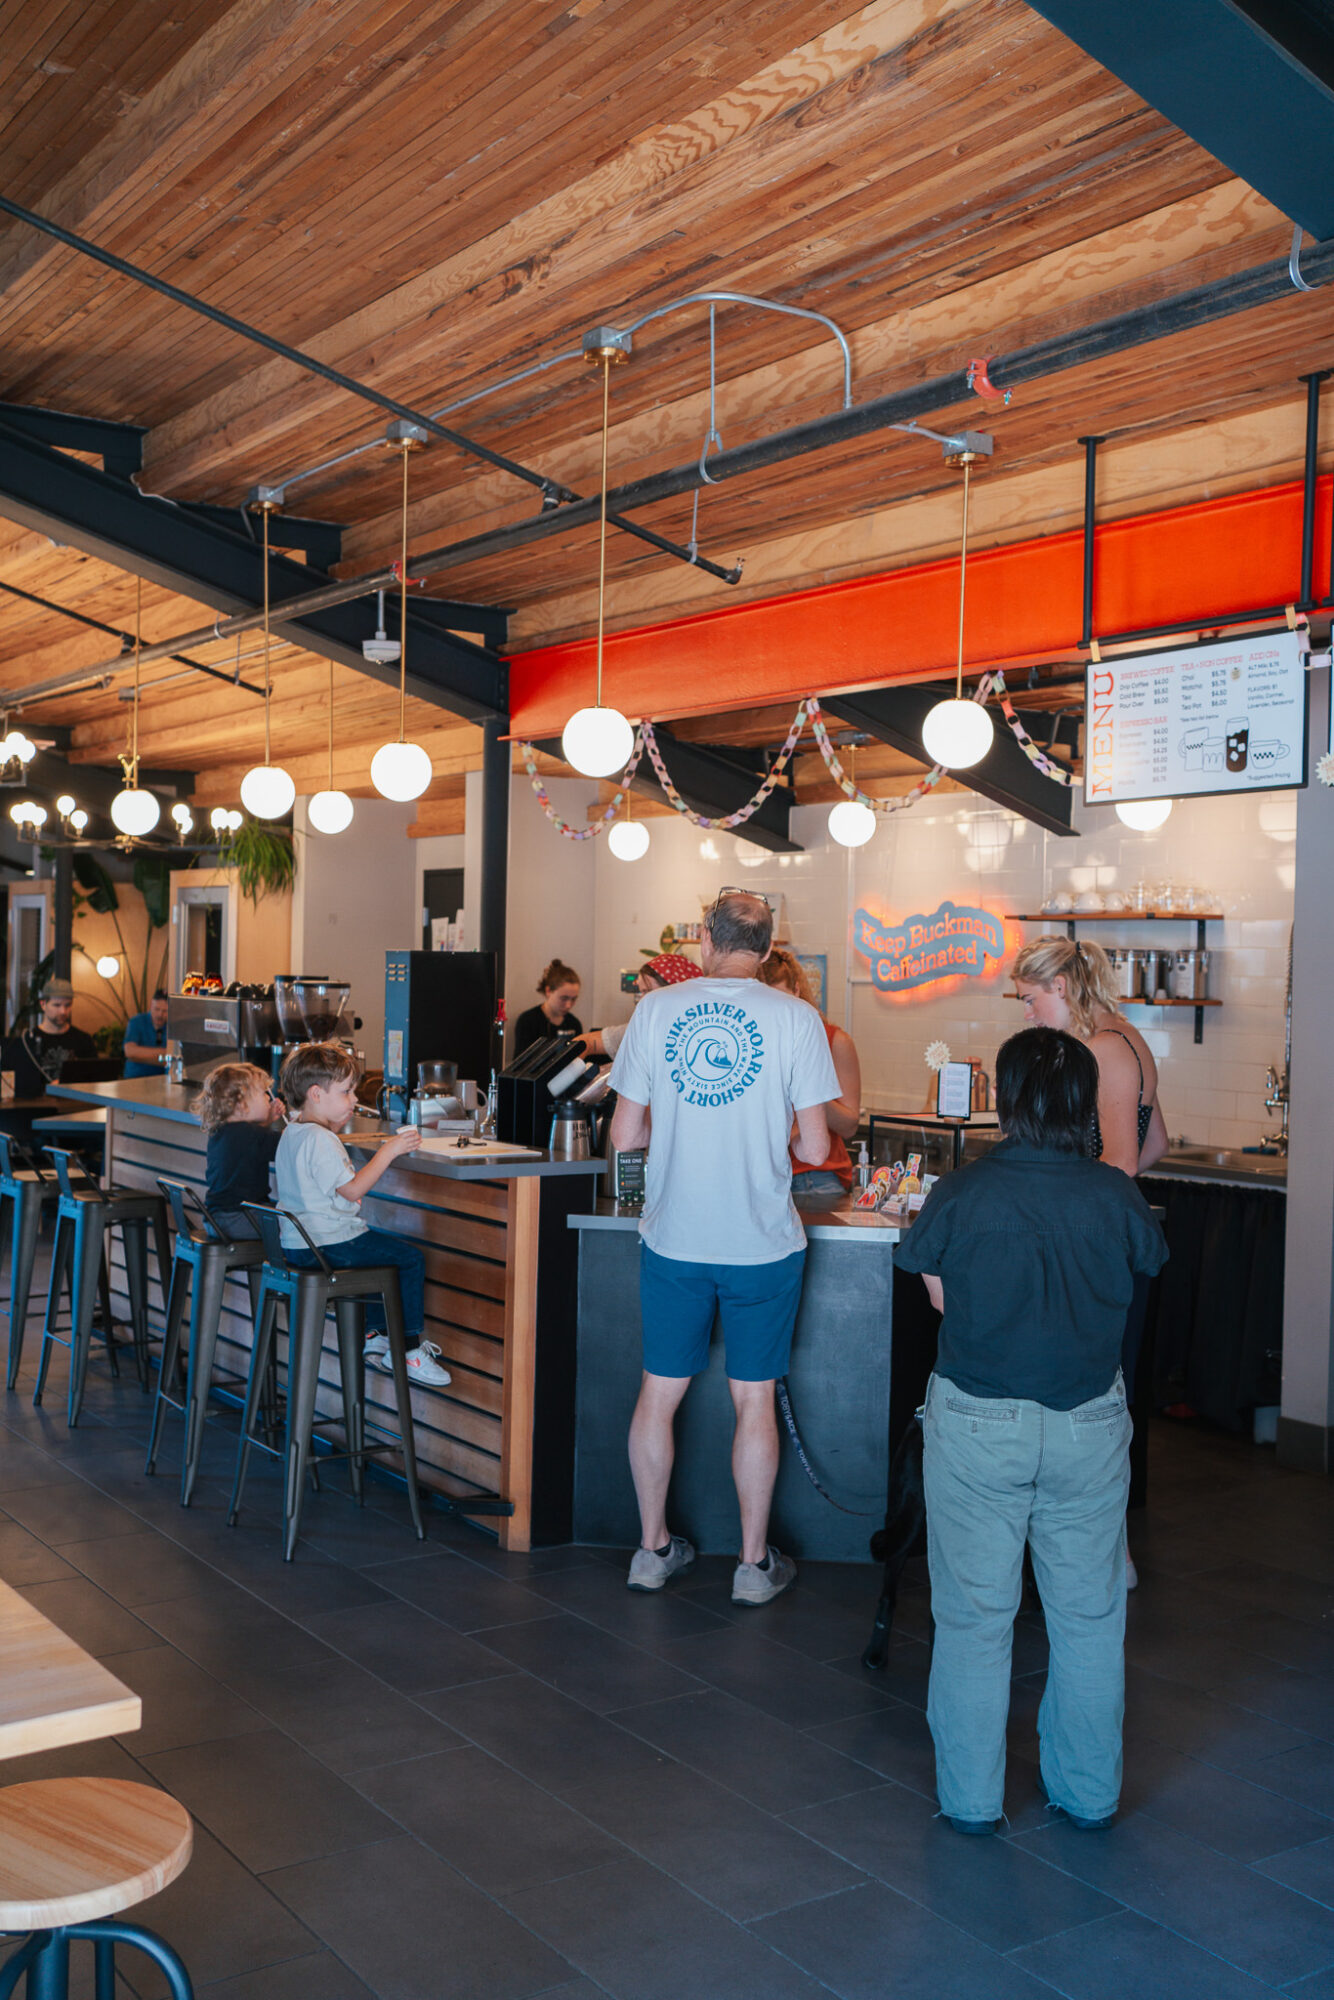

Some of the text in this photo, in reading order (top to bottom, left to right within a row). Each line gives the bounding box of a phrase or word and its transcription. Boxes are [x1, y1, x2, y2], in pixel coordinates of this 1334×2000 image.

[1215, 655, 1243, 666] COFFEE
[1149, 665, 1176, 676] COFFEE
[1131, 681, 1149, 689] Coffee
[1154, 677, 1169, 686] $4.00
[1120, 692, 1132, 700] Cold
[1132, 691, 1145, 699] Brew
[1120, 701, 1131, 709] Pour
[1153, 715, 1168, 725] BAR
[1092, 671, 1114, 796] MENU
[1153, 727, 1169, 736] $4.00
[861, 912, 998, 958] Keep Buckman
[876, 940, 978, 982] Caffeinated
[687, 1016, 729, 1033] MOUNTAIN
[730, 1023, 743, 1037] AND
[664, 1002, 747, 1063] QUIKSILVER
[678, 1033, 688, 1048] THE
[740, 1038, 748, 1053] THE
[733, 1056, 748, 1078] WAVE
[670, 1068, 686, 1094] CO
[686, 1076, 708, 1090] SIXTY
[711, 1077, 733, 1091] SINCE
